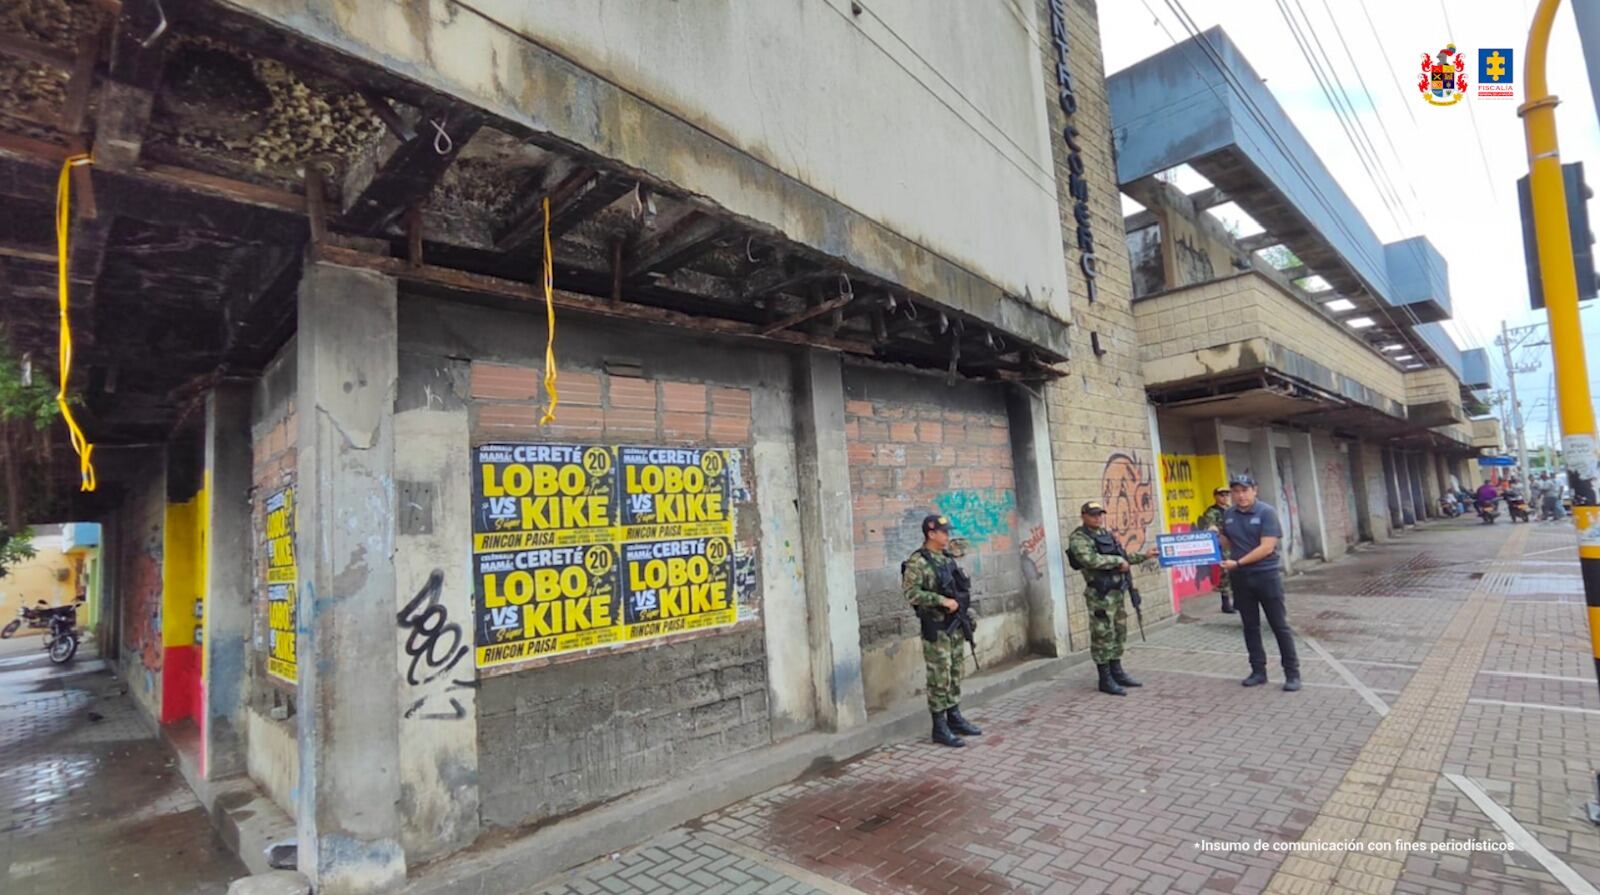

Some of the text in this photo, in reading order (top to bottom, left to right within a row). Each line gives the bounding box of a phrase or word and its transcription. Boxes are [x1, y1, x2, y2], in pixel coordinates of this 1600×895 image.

[513, 445, 582, 463] CERETÉ
[588, 452, 606, 470] 20
[649, 450, 700, 465] CERETÉ
[704, 455, 718, 471] 20
[482, 464, 586, 497] LOBO
[626, 465, 704, 494] LOBO
[489, 495, 609, 530] VS KIKE
[631, 493, 723, 523] VS KIKE
[481, 535, 522, 550] RINCON
[525, 532, 555, 546] PAISA
[626, 527, 656, 539] RINCON
[659, 524, 682, 536] PAISA
[1176, 532, 1213, 541] OCUPADO
[515, 546, 584, 569] CERETÉ
[652, 538, 705, 558] CERETÉ
[709, 543, 724, 559] 20
[590, 551, 608, 569] 20
[629, 556, 709, 591] LOBO
[483, 565, 588, 608] LOBO
[635, 581, 727, 618] VS KIKE
[491, 595, 612, 638] VS KIKE
[662, 618, 685, 633] PAISA
[484, 643, 524, 663] RINCON
[527, 638, 557, 655] PAISA
